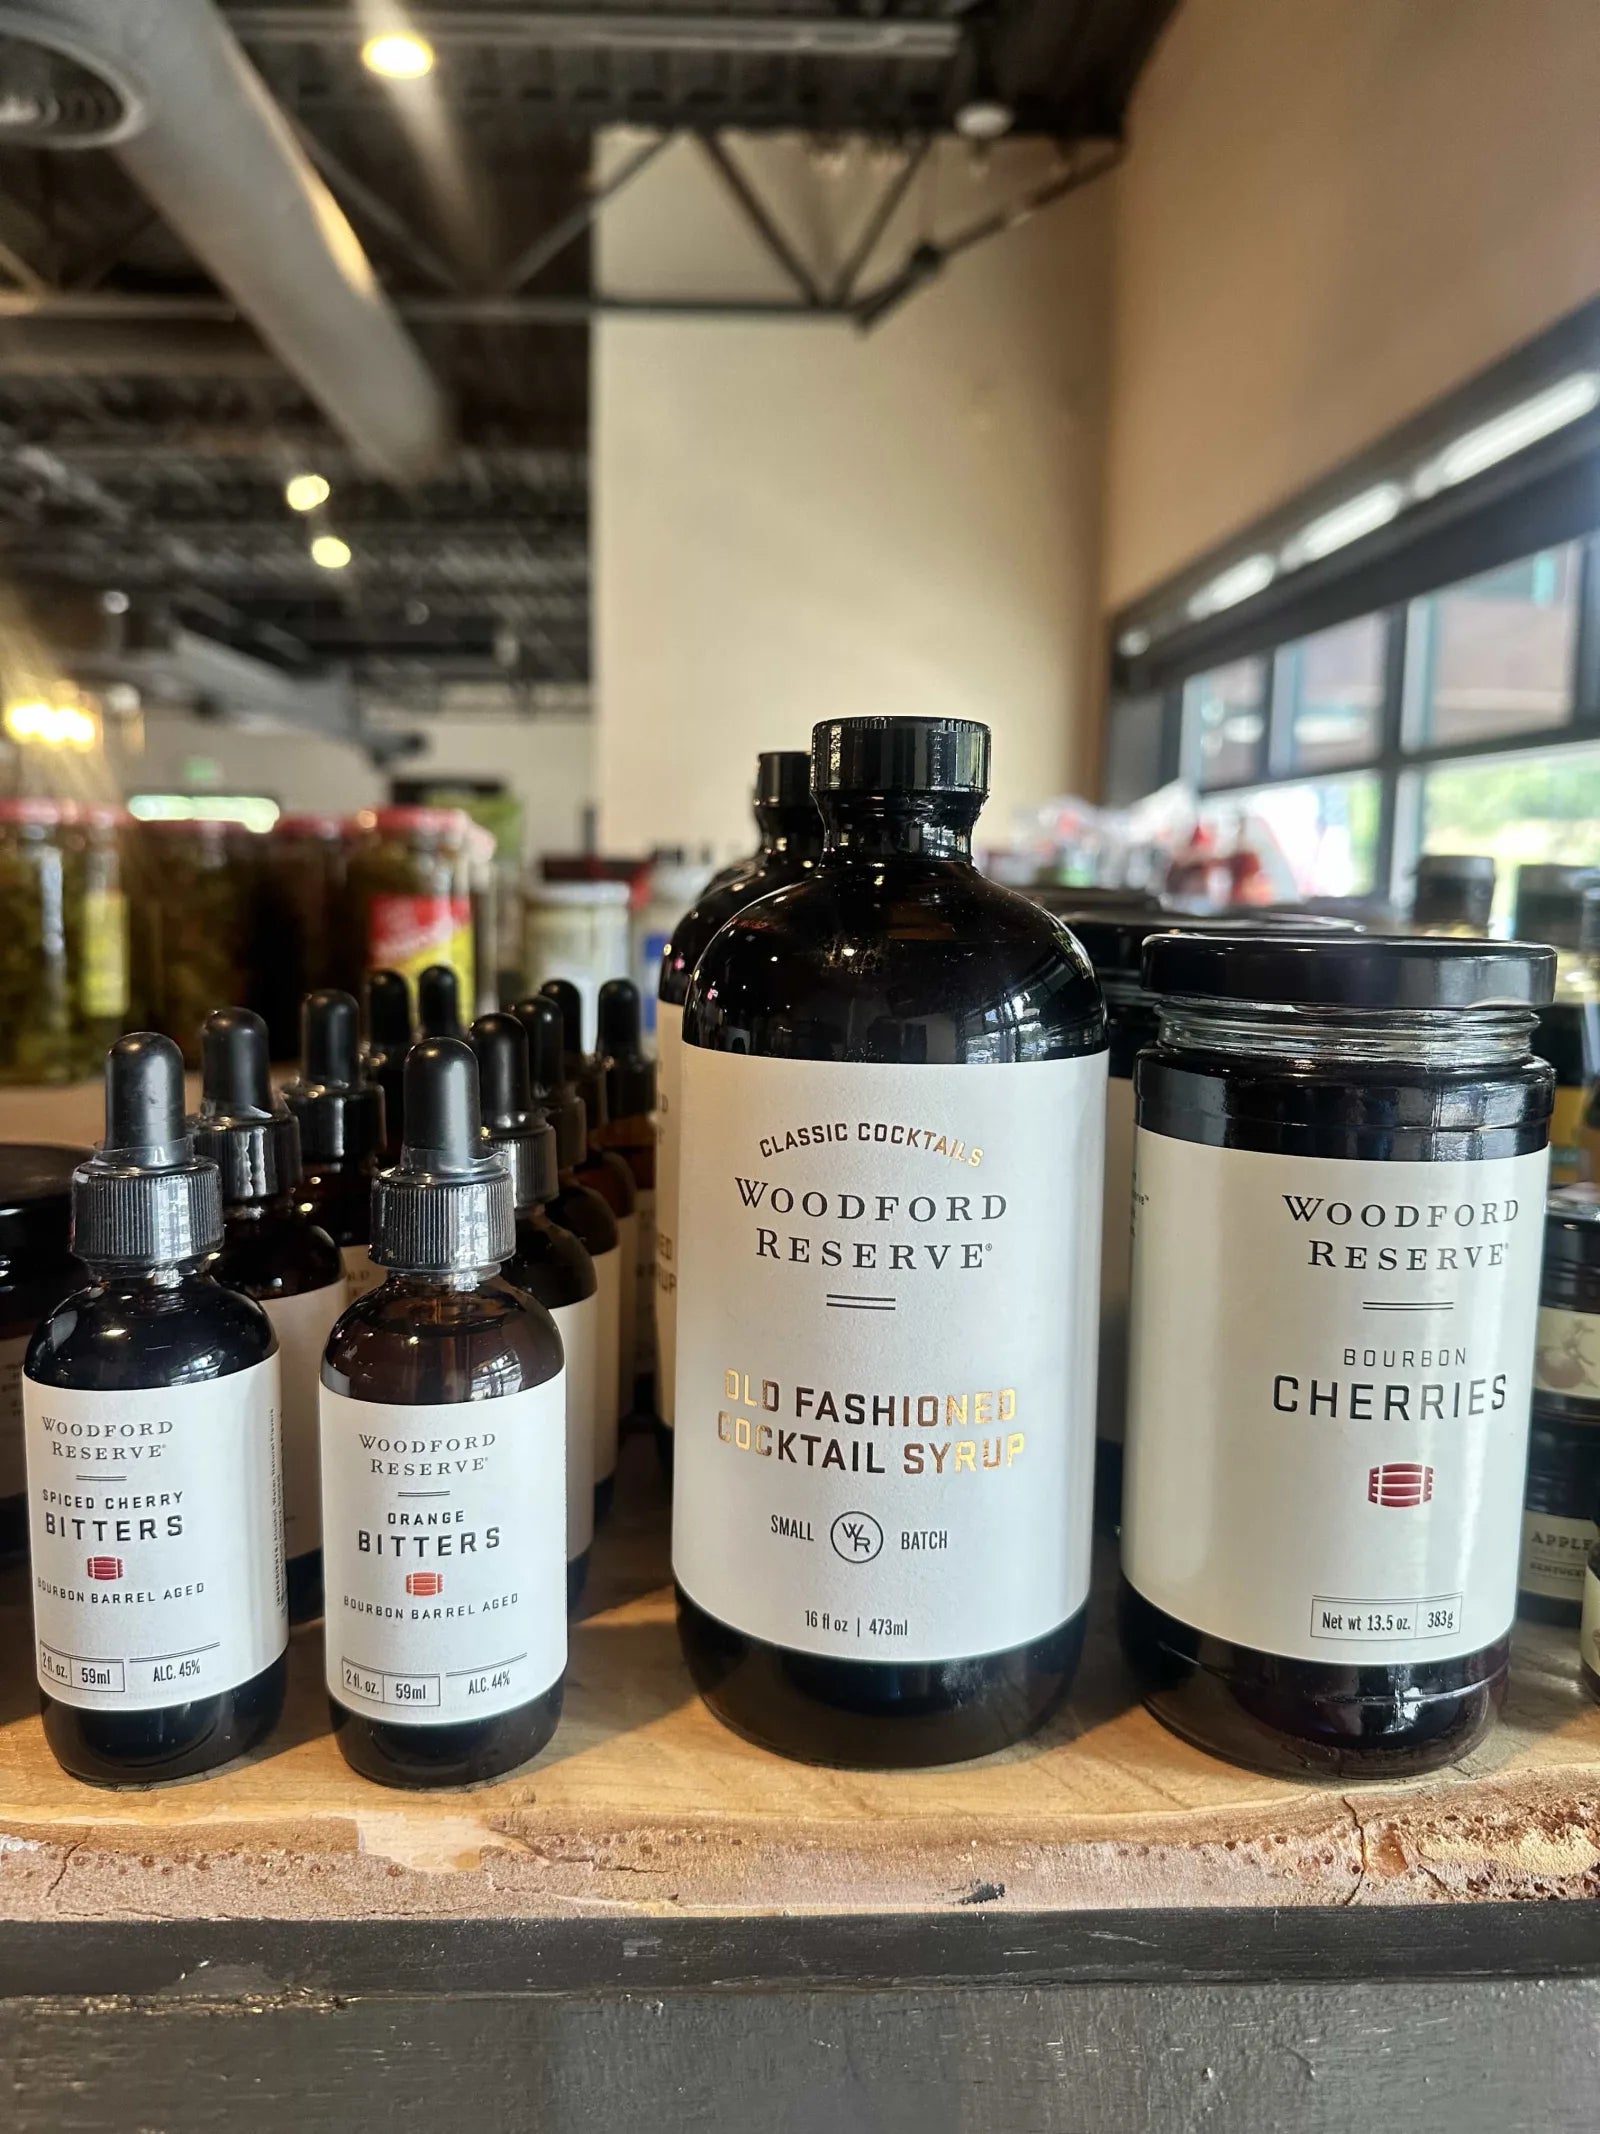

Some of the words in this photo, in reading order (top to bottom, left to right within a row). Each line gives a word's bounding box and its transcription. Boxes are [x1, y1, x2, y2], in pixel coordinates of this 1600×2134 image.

[759, 1123, 848, 1158] CLASSIC
[858, 1123, 984, 1167] COCKTAILS
[735, 1177, 1007, 1222] WOODFORD
[1282, 1195, 1519, 1228] WOODFORD
[1343, 1348, 1466, 1368] BOURBON
[724, 1368, 780, 1412] OLD
[796, 1388, 1017, 1427] FASHIONED
[1273, 1373, 1507, 1421] CHERRIES
[42, 1416, 173, 1437] WOODFORD
[358, 1433, 496, 1453] WOODFORD
[718, 1410, 886, 1474] COCKTAIL
[903, 1432, 1025, 1474] SYRUP
[42, 1489, 95, 1509] SPICED
[105, 1491, 183, 1509] CHERRY
[45, 1512, 183, 1541] BITTERS
[388, 1511, 464, 1525] ORANGE
[771, 1514, 815, 1541] SMALL
[901, 1530, 947, 1550] BATCH
[358, 1527, 500, 1557] BITTERS
[38, 1577, 85, 1602] BOURBON
[91, 1592, 156, 1604] BARREL
[163, 1582, 205, 1600] AGED
[343, 1595, 404, 1619] BOURBON
[411, 1605, 476, 1620] BARREL
[482, 1593, 518, 1612] AGED
[1322, 1611, 1343, 1630] Net
[1348, 1616, 1361, 1631] wt
[1367, 1615, 1393, 1631] 13.5
[1396, 1618, 1411, 1631] oz.
[1427, 1610, 1454, 1629] 383g
[805, 1610, 818, 1628] 16
[822, 1613, 830, 1630] fl
[834, 1619, 848, 1632] oz
[869, 1618, 908, 1636] 473ml
[42, 1652, 48, 1666] 2
[56, 1666, 68, 1679] oz.
[81, 1668, 111, 1685] 59ml
[153, 1665, 176, 1682] ALC.
[179, 1658, 201, 1677] 45%
[468, 1679, 490, 1695] ALC.
[491, 1670, 511, 1689] 44%
[345, 1670, 352, 1685] 2
[353, 1675, 362, 1690] fl.
[365, 1682, 380, 1695] oz.
[395, 1684, 426, 1700] 59ml
